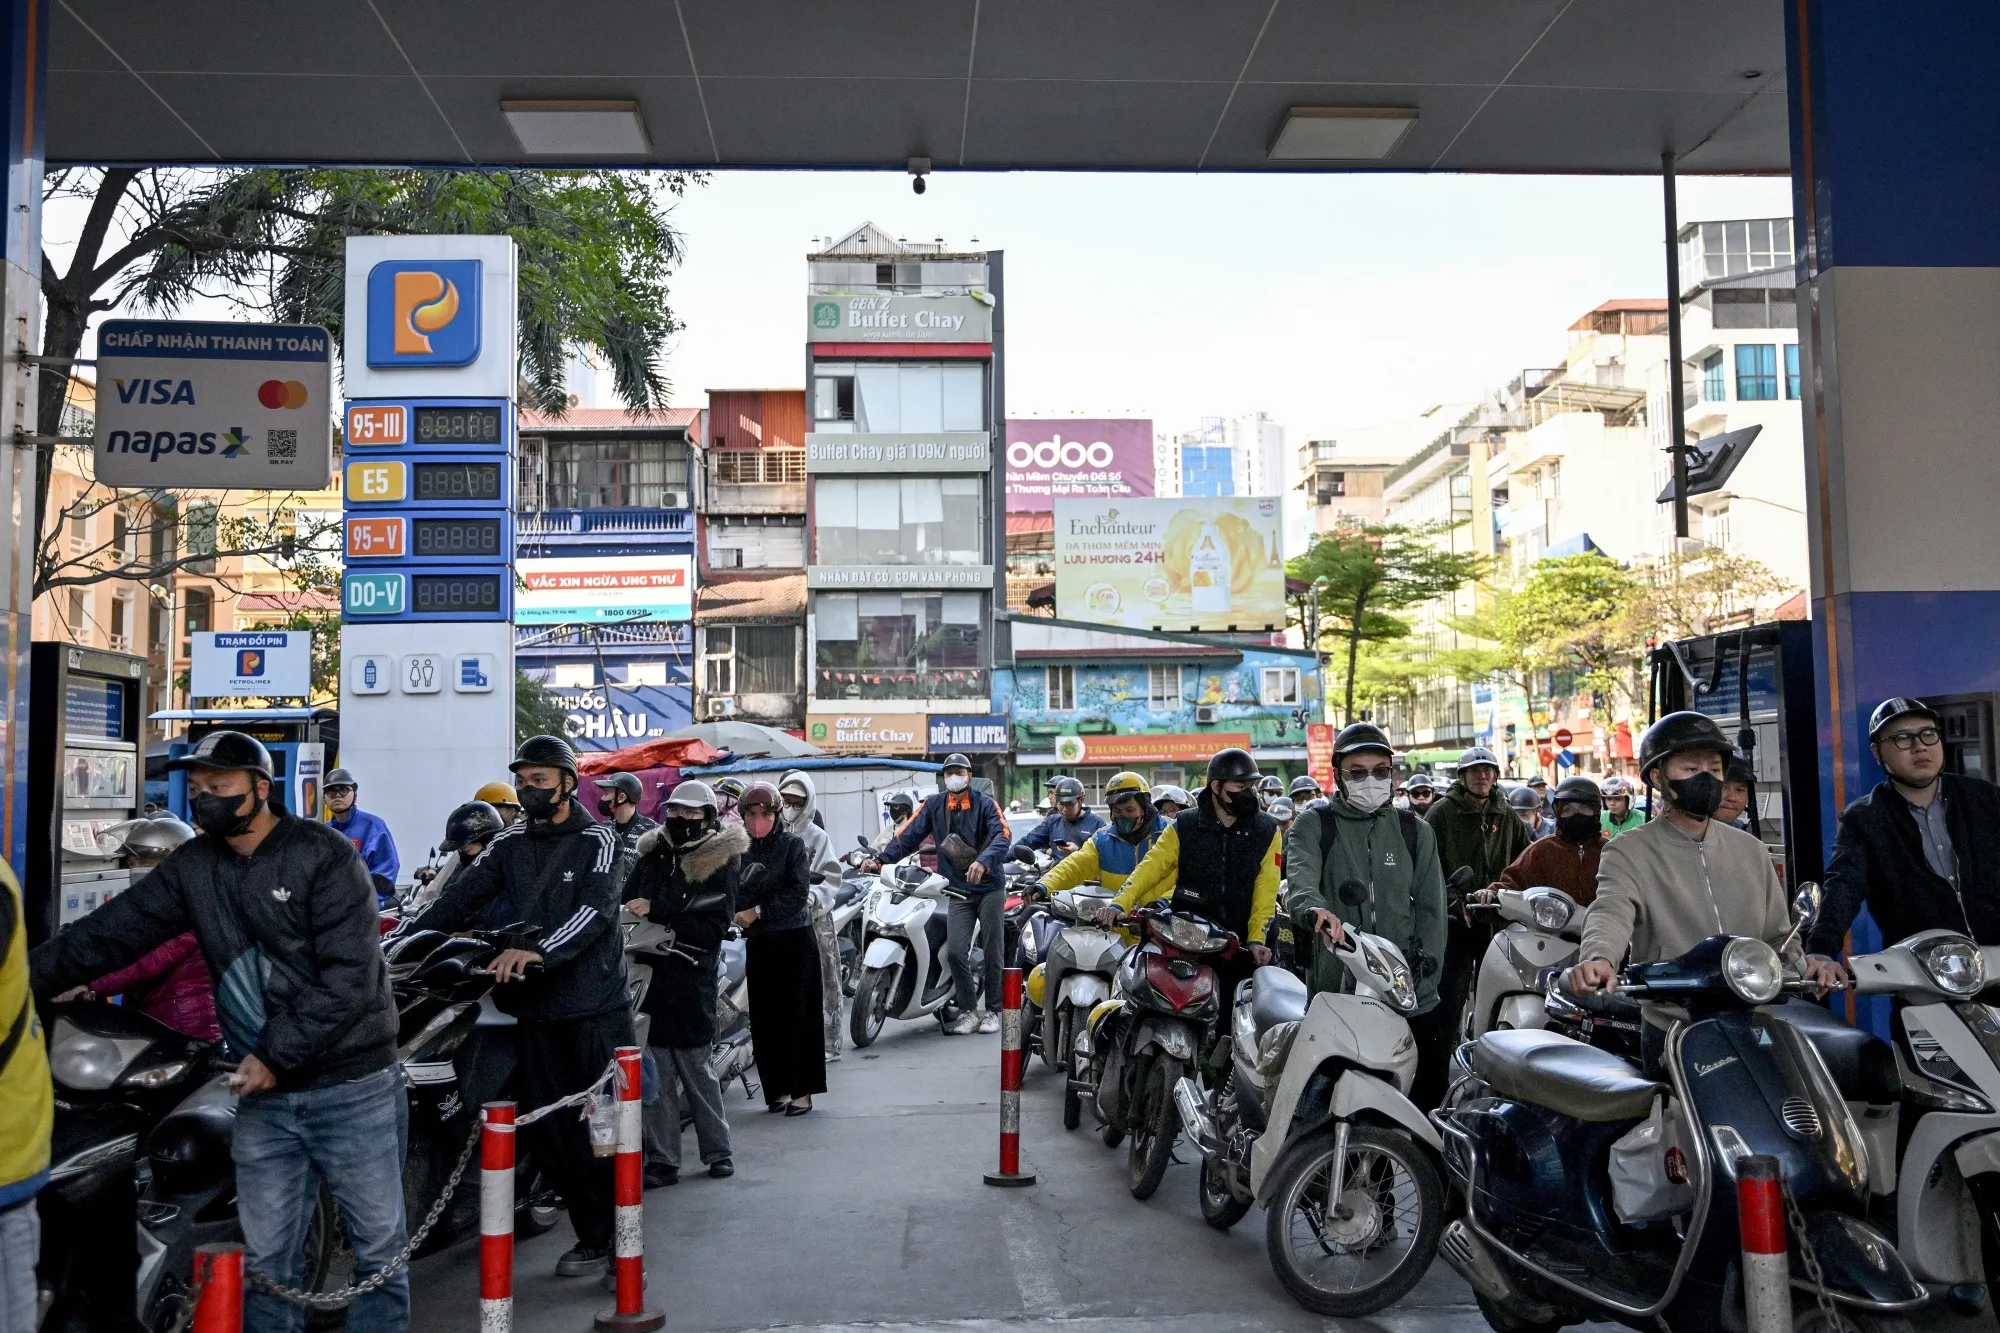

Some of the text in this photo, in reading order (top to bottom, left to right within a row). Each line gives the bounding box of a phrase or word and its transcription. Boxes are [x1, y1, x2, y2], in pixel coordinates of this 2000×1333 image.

[850, 298, 892, 310] GEN Z
[849, 310, 965, 331] Buffet Chay
[105, 329, 324, 352] CHẤP NHẬN THANH TOÁN
[109, 378, 196, 406] VISA
[353, 413, 400, 438] 95-III
[106, 430, 217, 463] napas
[810, 443, 986, 461] Buffet Chay giá 109k/ người
[1007, 434, 1113, 468] odoo
[363, 468, 389, 494] E5
[1071, 485, 1085, 494] Ra
[1070, 514, 1156, 535] Enchanteur
[1065, 542, 1080, 550] DA
[1064, 551, 1165, 564] LƯU HƯƠNG 24H
[559, 577, 580, 587] XIN
[583, 574, 619, 586] NGỪA
[621, 576, 647, 586] UNG
[650, 573, 677, 585] THƯ
[820, 571, 849, 584] NHẬN
[895, 570, 919, 582] CƠM
[350, 581, 398, 607] DO-V
[220, 637, 247, 648] TRẠM
[267, 637, 283, 645] PIN
[550, 690, 607, 710] THUỐC
[563, 708, 647, 738] CHÂU
[836, 717, 872, 729] GEN Z
[930, 721, 1007, 744] ĐỨC ANH HOTEL
[836, 729, 914, 744] Buffet Chay
[1170, 744, 1196, 752] NON
[1611, 1021, 1636, 1031] HONDA
[1694, 1056, 1738, 1077] Vespa
